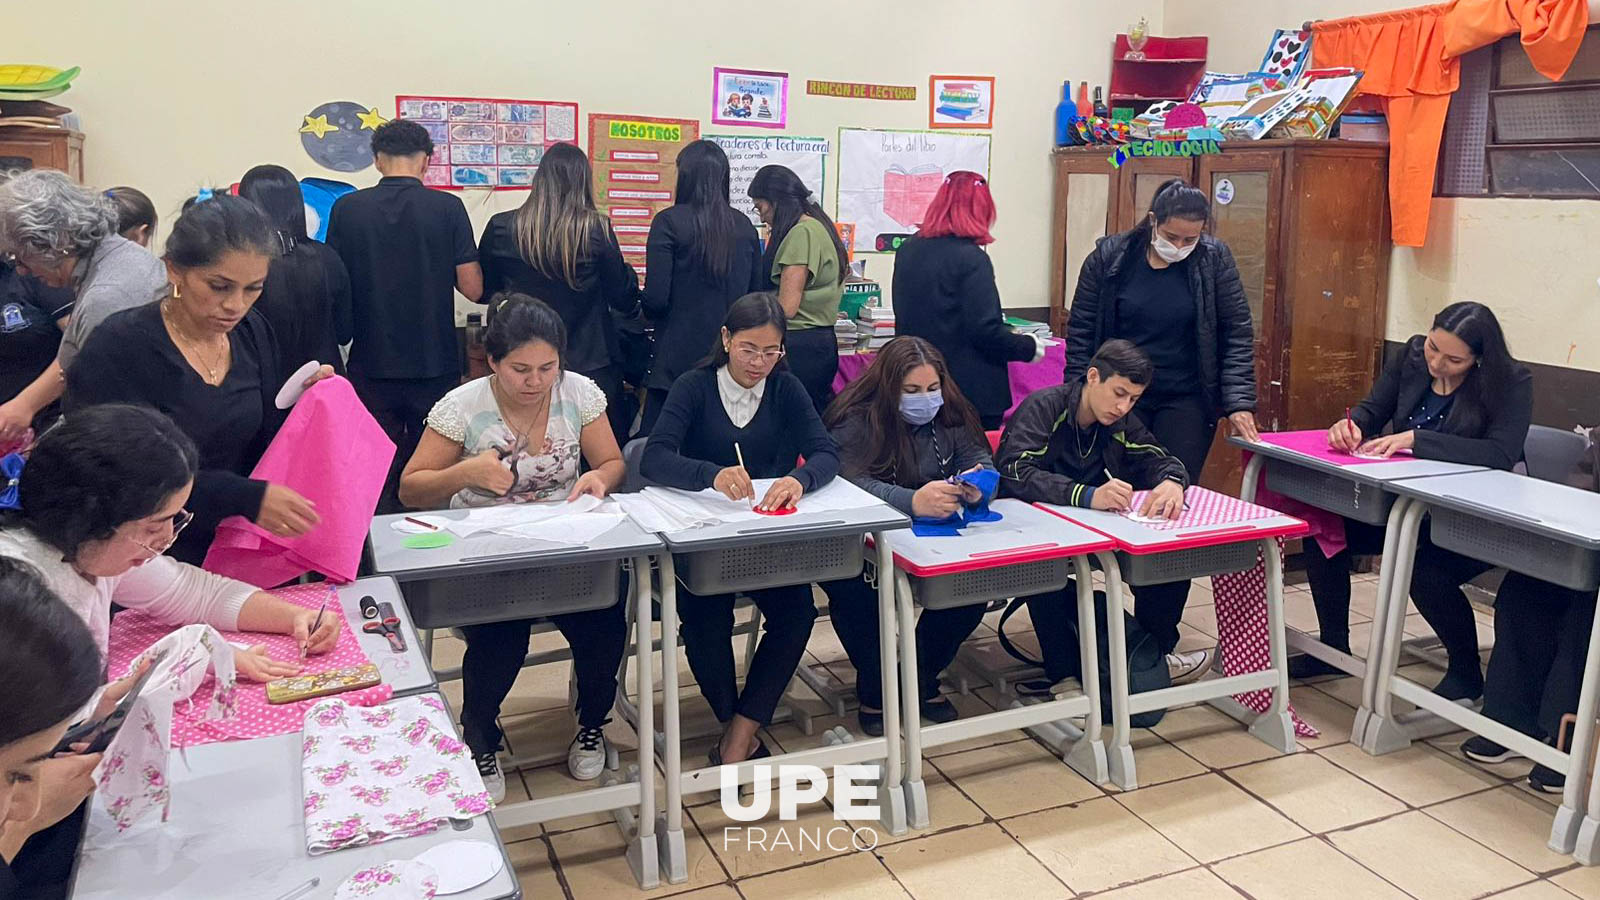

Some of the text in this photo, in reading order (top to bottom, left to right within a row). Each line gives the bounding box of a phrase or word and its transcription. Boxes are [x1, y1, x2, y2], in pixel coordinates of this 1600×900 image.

[853, 84, 866, 97] DE
[869, 86, 915, 99] LECTURA
[611, 122, 680, 140] NOSOTROS
[761, 137, 772, 150] de
